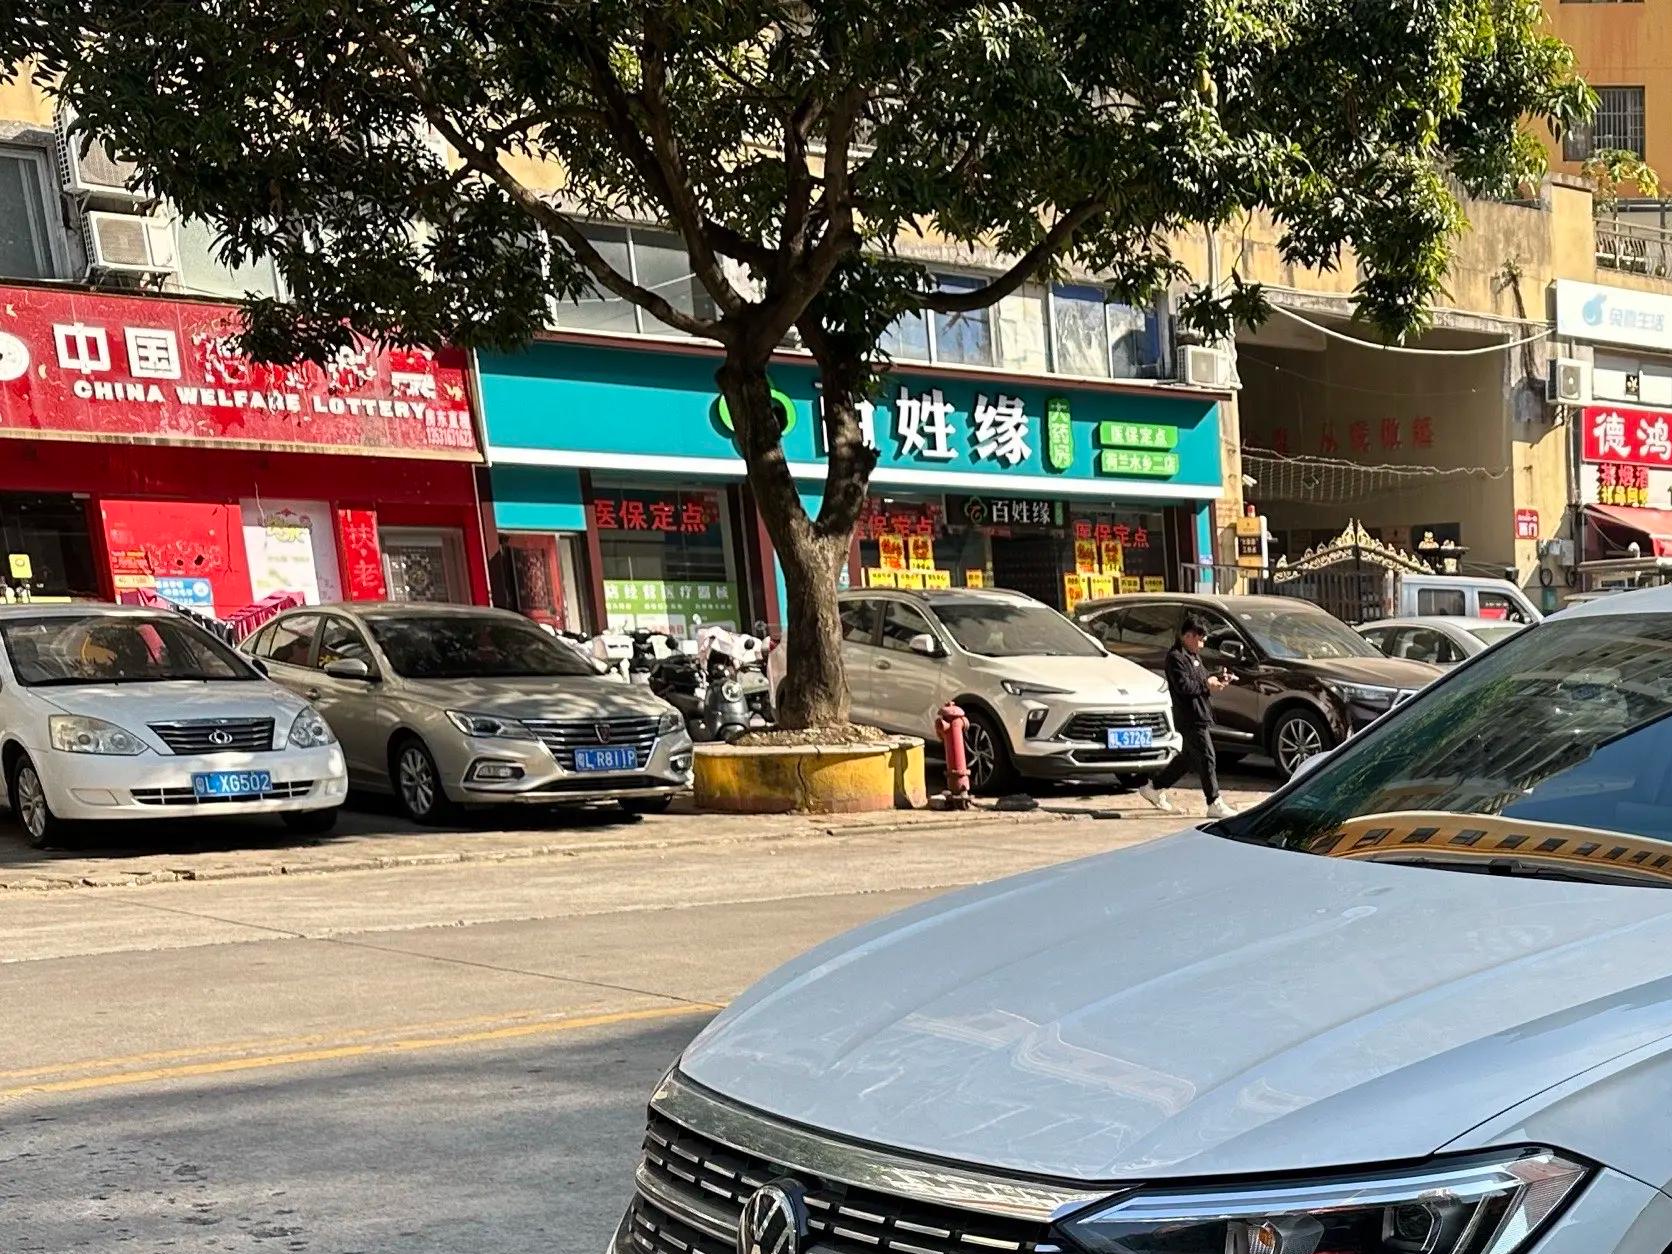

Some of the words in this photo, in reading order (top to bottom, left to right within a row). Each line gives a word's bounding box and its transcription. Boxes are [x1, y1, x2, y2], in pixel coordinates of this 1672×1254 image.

[73, 379, 166, 403] CHINA
[311, 395, 426, 420] LOTTERY
[1050, 401, 1071, 469] 大药房
[1110, 424, 1168, 448] 医保定点
[1600, 464, 1649, 487] 茶烟酒
[594, 499, 707, 533] 医保定点
[992, 500, 1051, 524] 百姓缘
